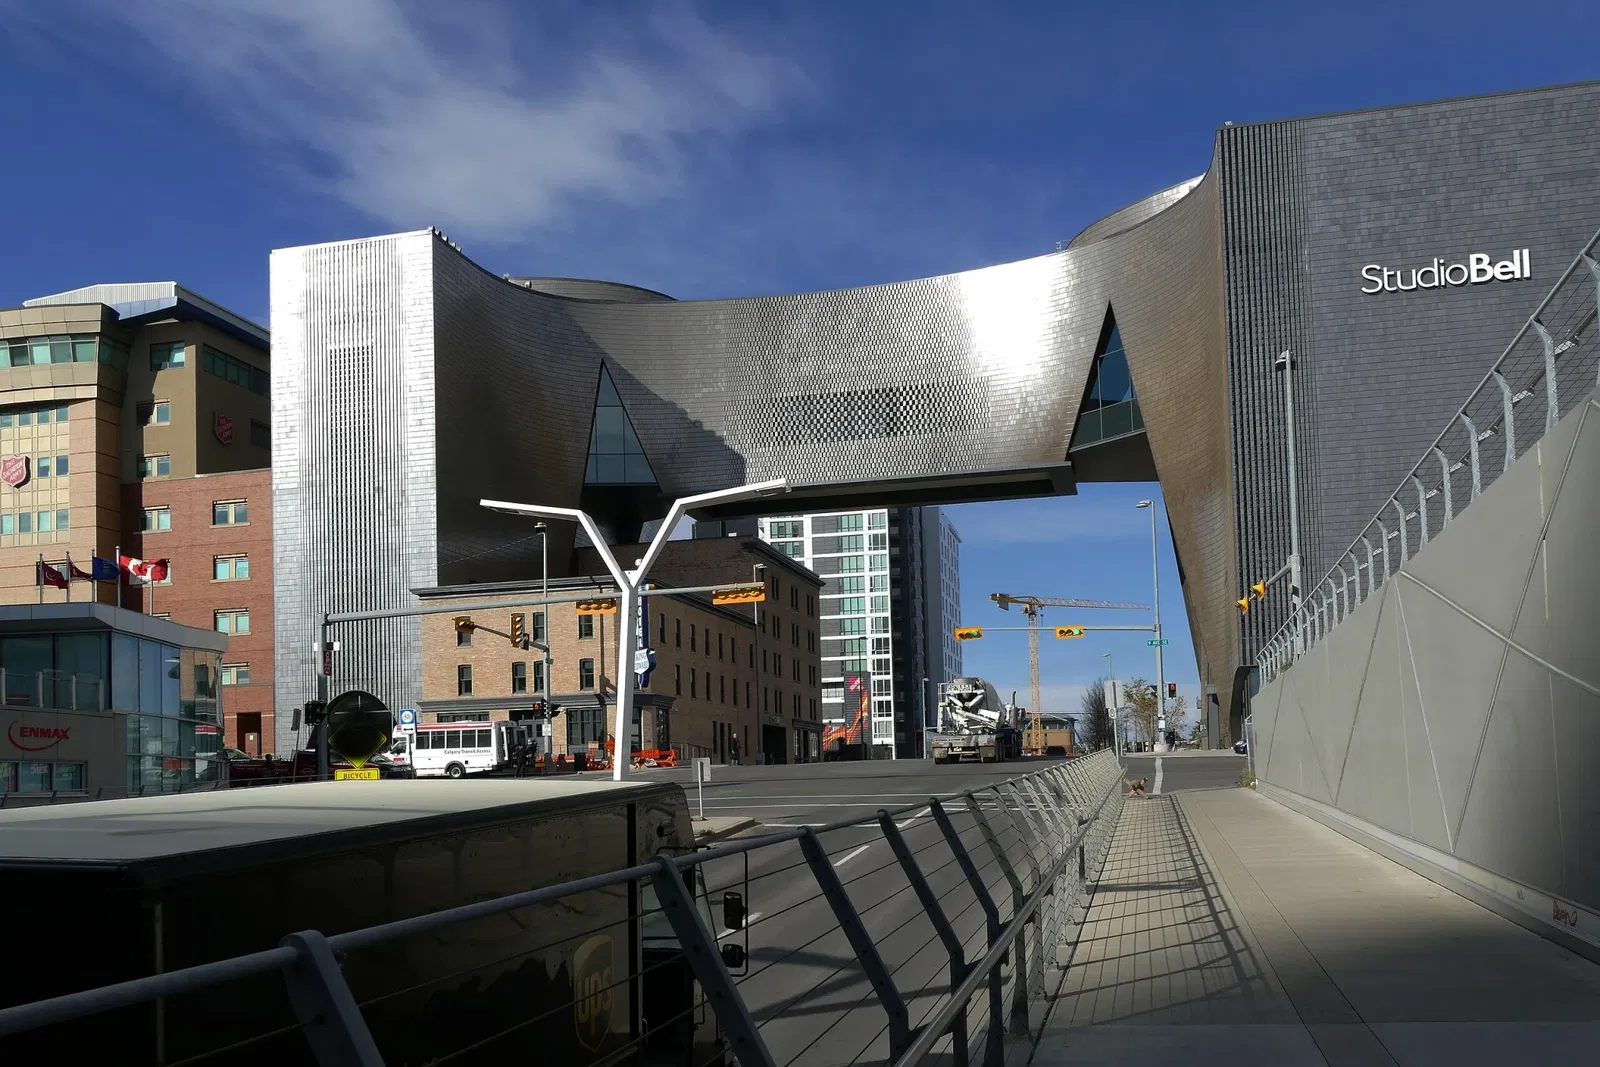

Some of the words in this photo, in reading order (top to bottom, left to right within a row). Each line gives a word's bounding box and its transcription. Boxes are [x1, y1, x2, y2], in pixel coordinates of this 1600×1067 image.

[1361, 248, 1531, 293] StudioBell
[5, 459, 15, 468] THE
[9, 467, 23, 482] ARMY
[19, 726, 71, 740] ENMAX
